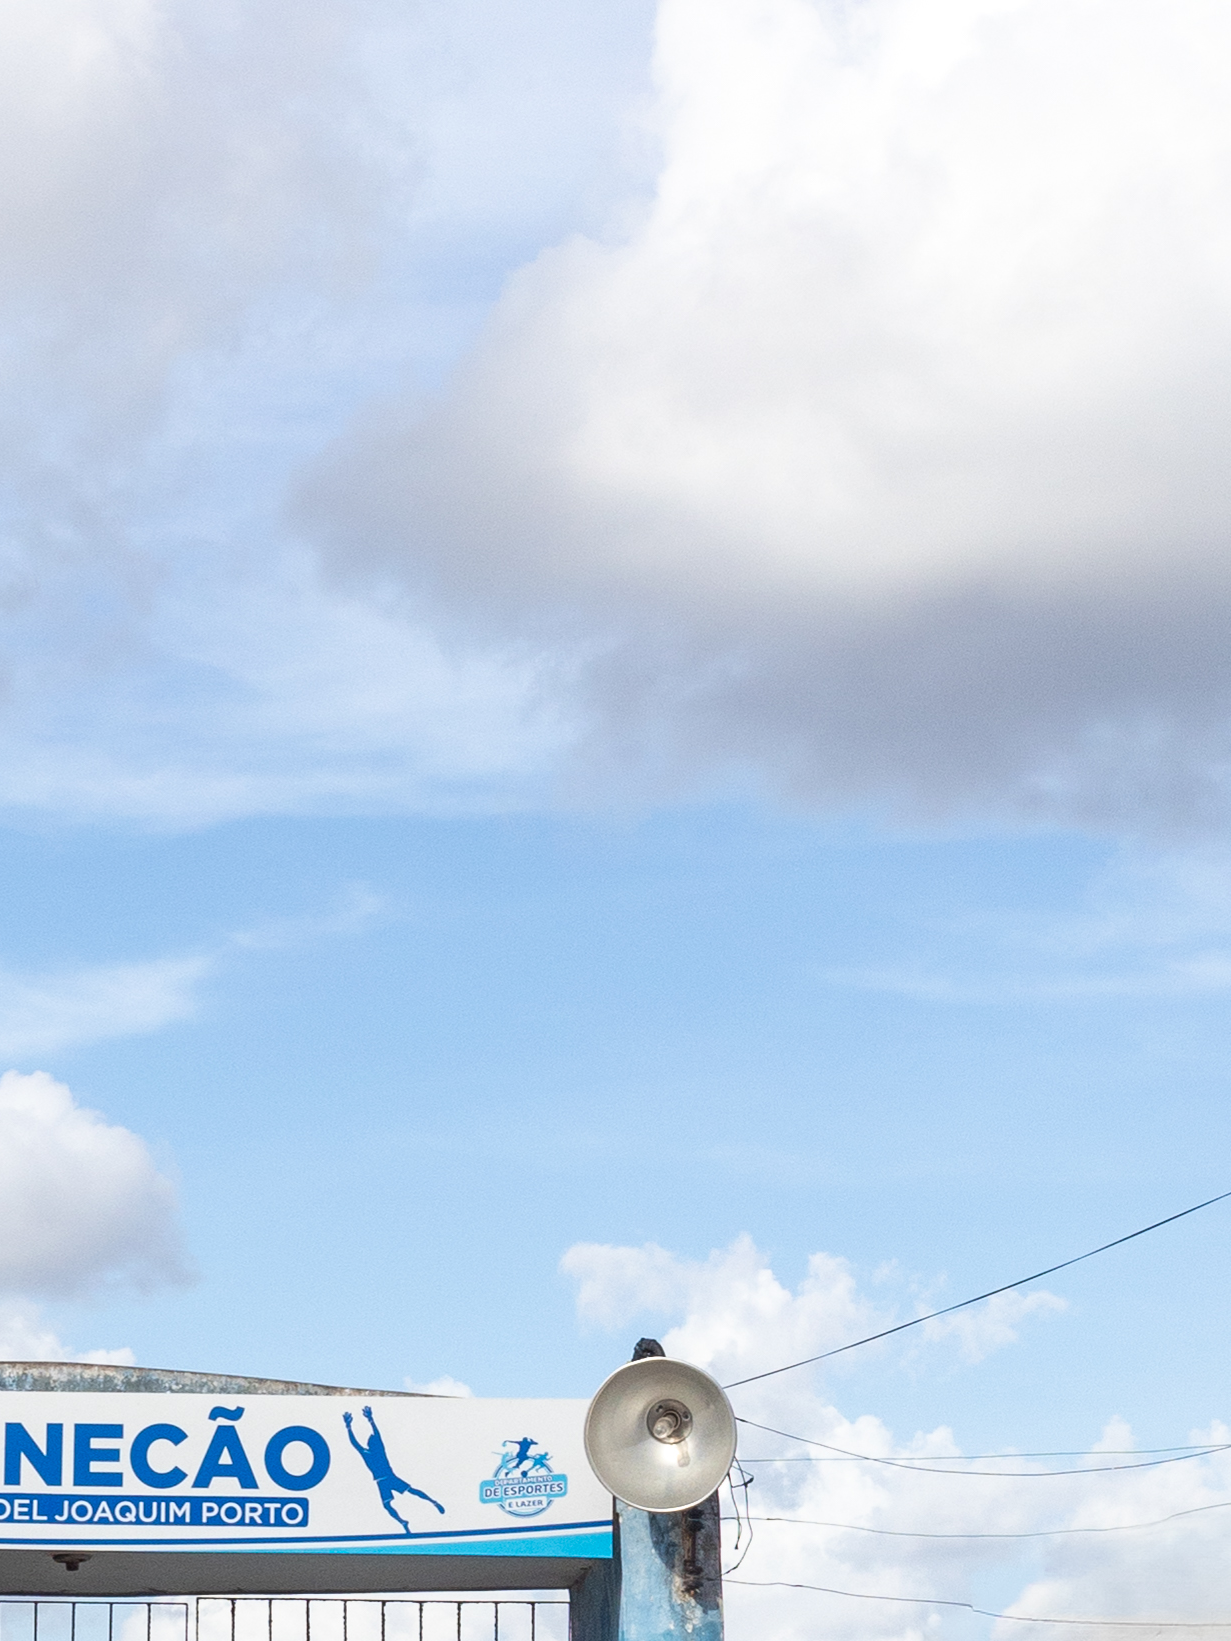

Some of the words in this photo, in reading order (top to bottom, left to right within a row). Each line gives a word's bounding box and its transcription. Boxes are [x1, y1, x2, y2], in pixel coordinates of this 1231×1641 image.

[494, 1475, 553, 1486] DEPARTAMENTO
[484, 1488, 500, 1498] DE
[503, 1482, 564, 1496] ESPORTES
[515, 1499, 544, 1508] LAZER
[54, 1500, 191, 1523] JOAQUIM
[201, 1502, 304, 1525] PORTO
